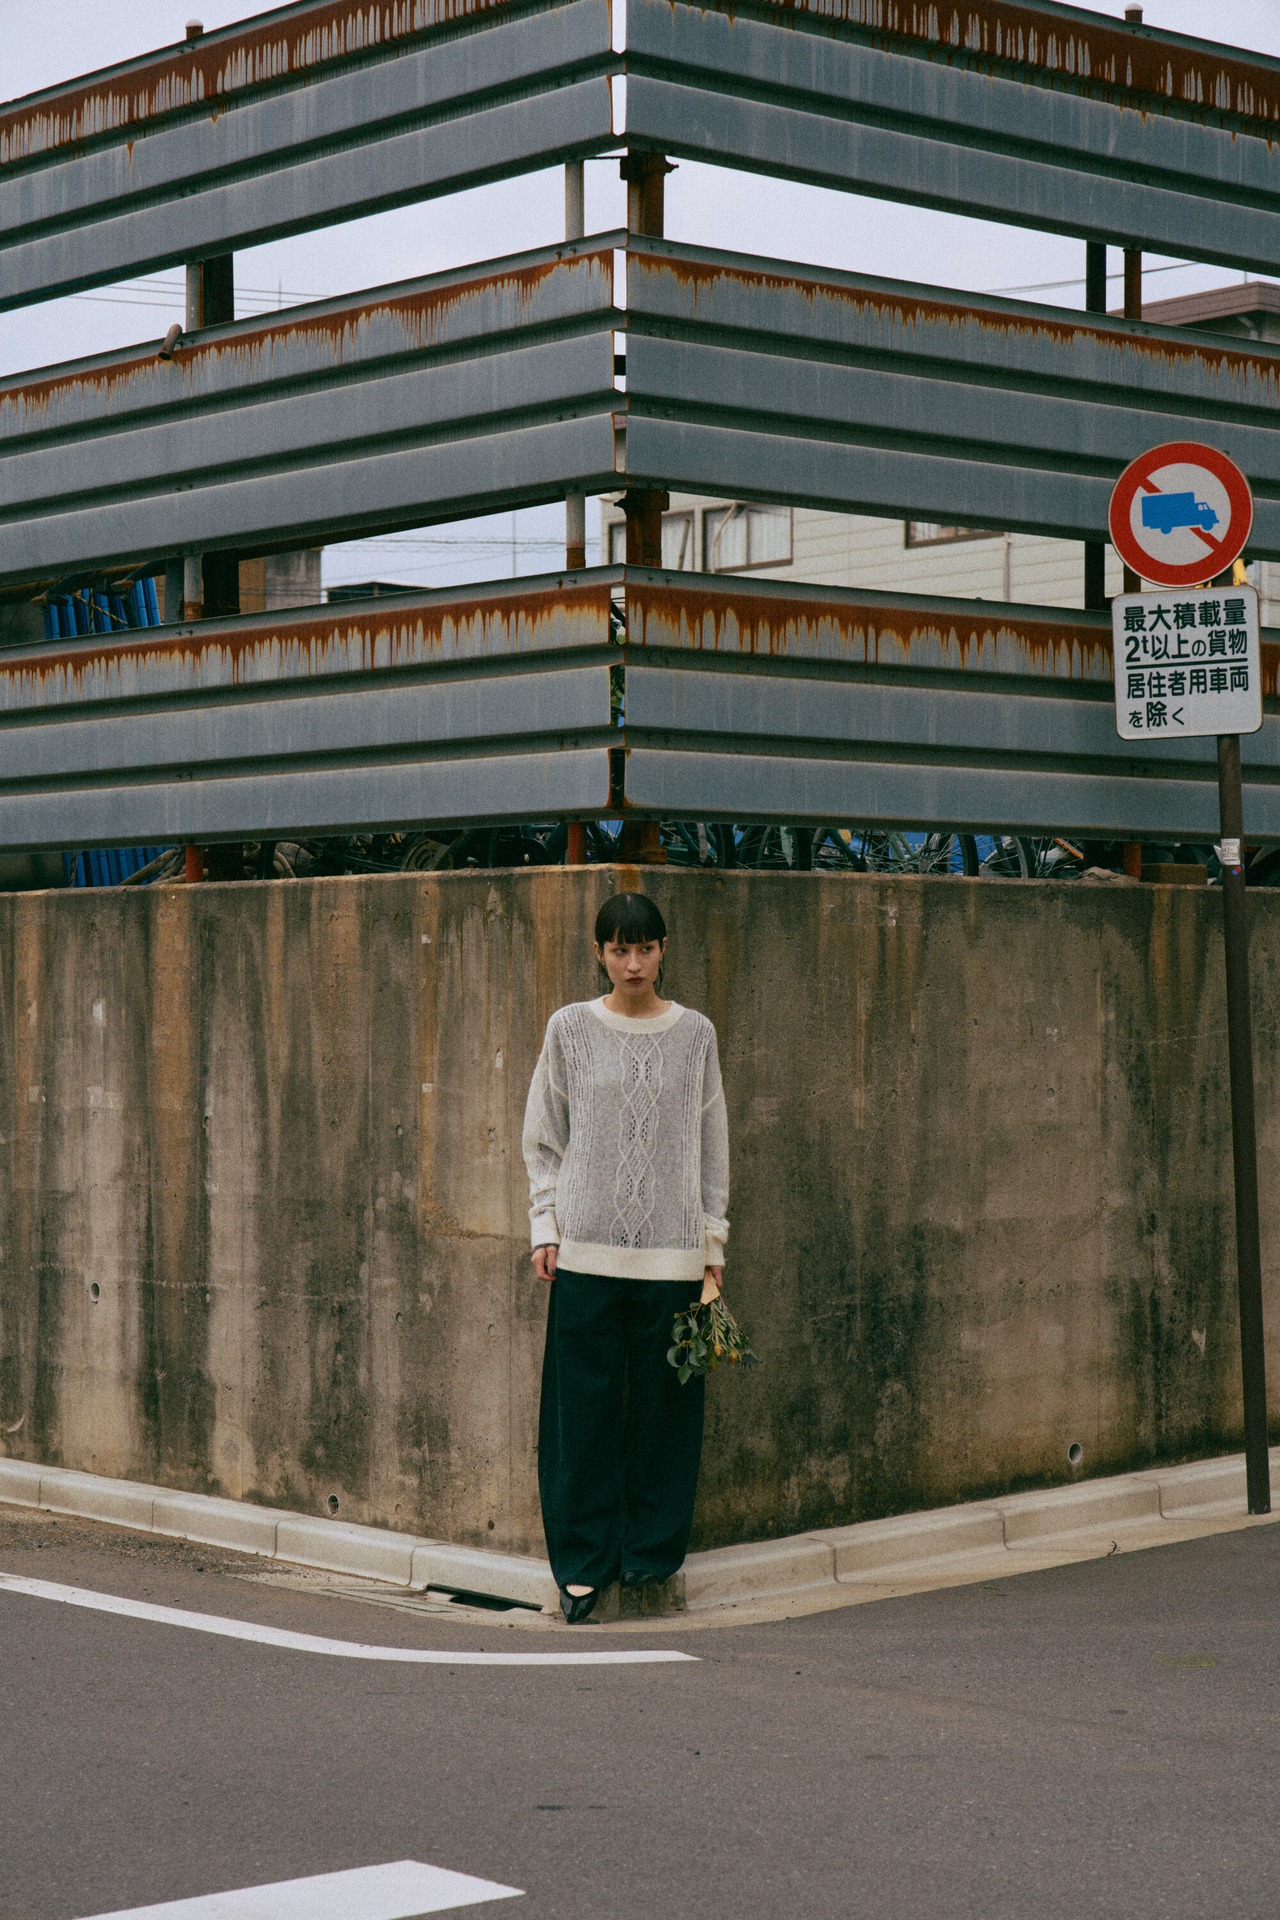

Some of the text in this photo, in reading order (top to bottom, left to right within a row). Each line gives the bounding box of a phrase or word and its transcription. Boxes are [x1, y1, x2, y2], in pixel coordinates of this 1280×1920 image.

[1124, 599, 1247, 633] 最大積載量
[1125, 628, 1248, 663] 2t以上の貨物
[1127, 666, 1249, 700] 居住者用車両
[1128, 701, 1185, 729] を除く
